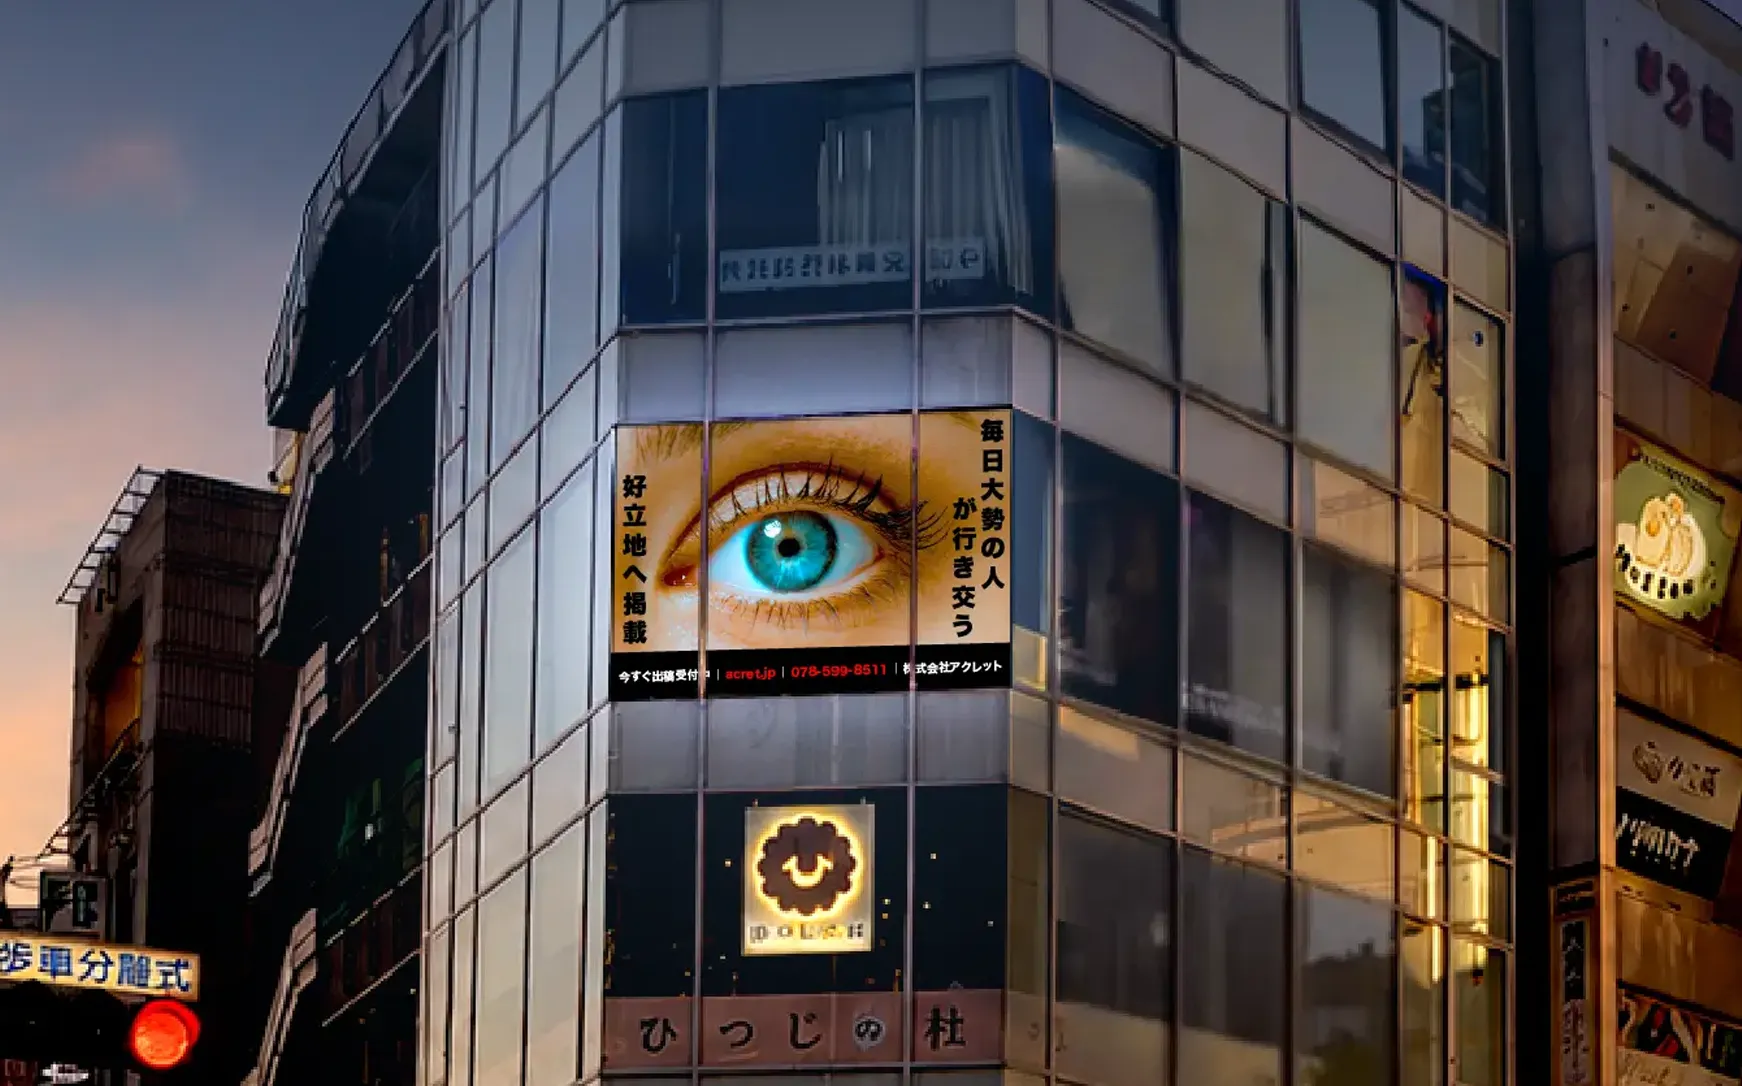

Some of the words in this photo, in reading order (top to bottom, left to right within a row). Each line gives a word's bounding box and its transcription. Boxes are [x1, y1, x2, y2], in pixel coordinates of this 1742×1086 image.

[622, 474, 648, 645] 好立地へ掲載
[952, 497, 978, 639] が行き交う
[980, 418, 1005, 591] 毎日大勢の人
[725, 667, 776, 680] acret.jp
[790, 664, 887, 678] 078-599-8511
[640, 1003, 967, 1054] ひつじの杜
